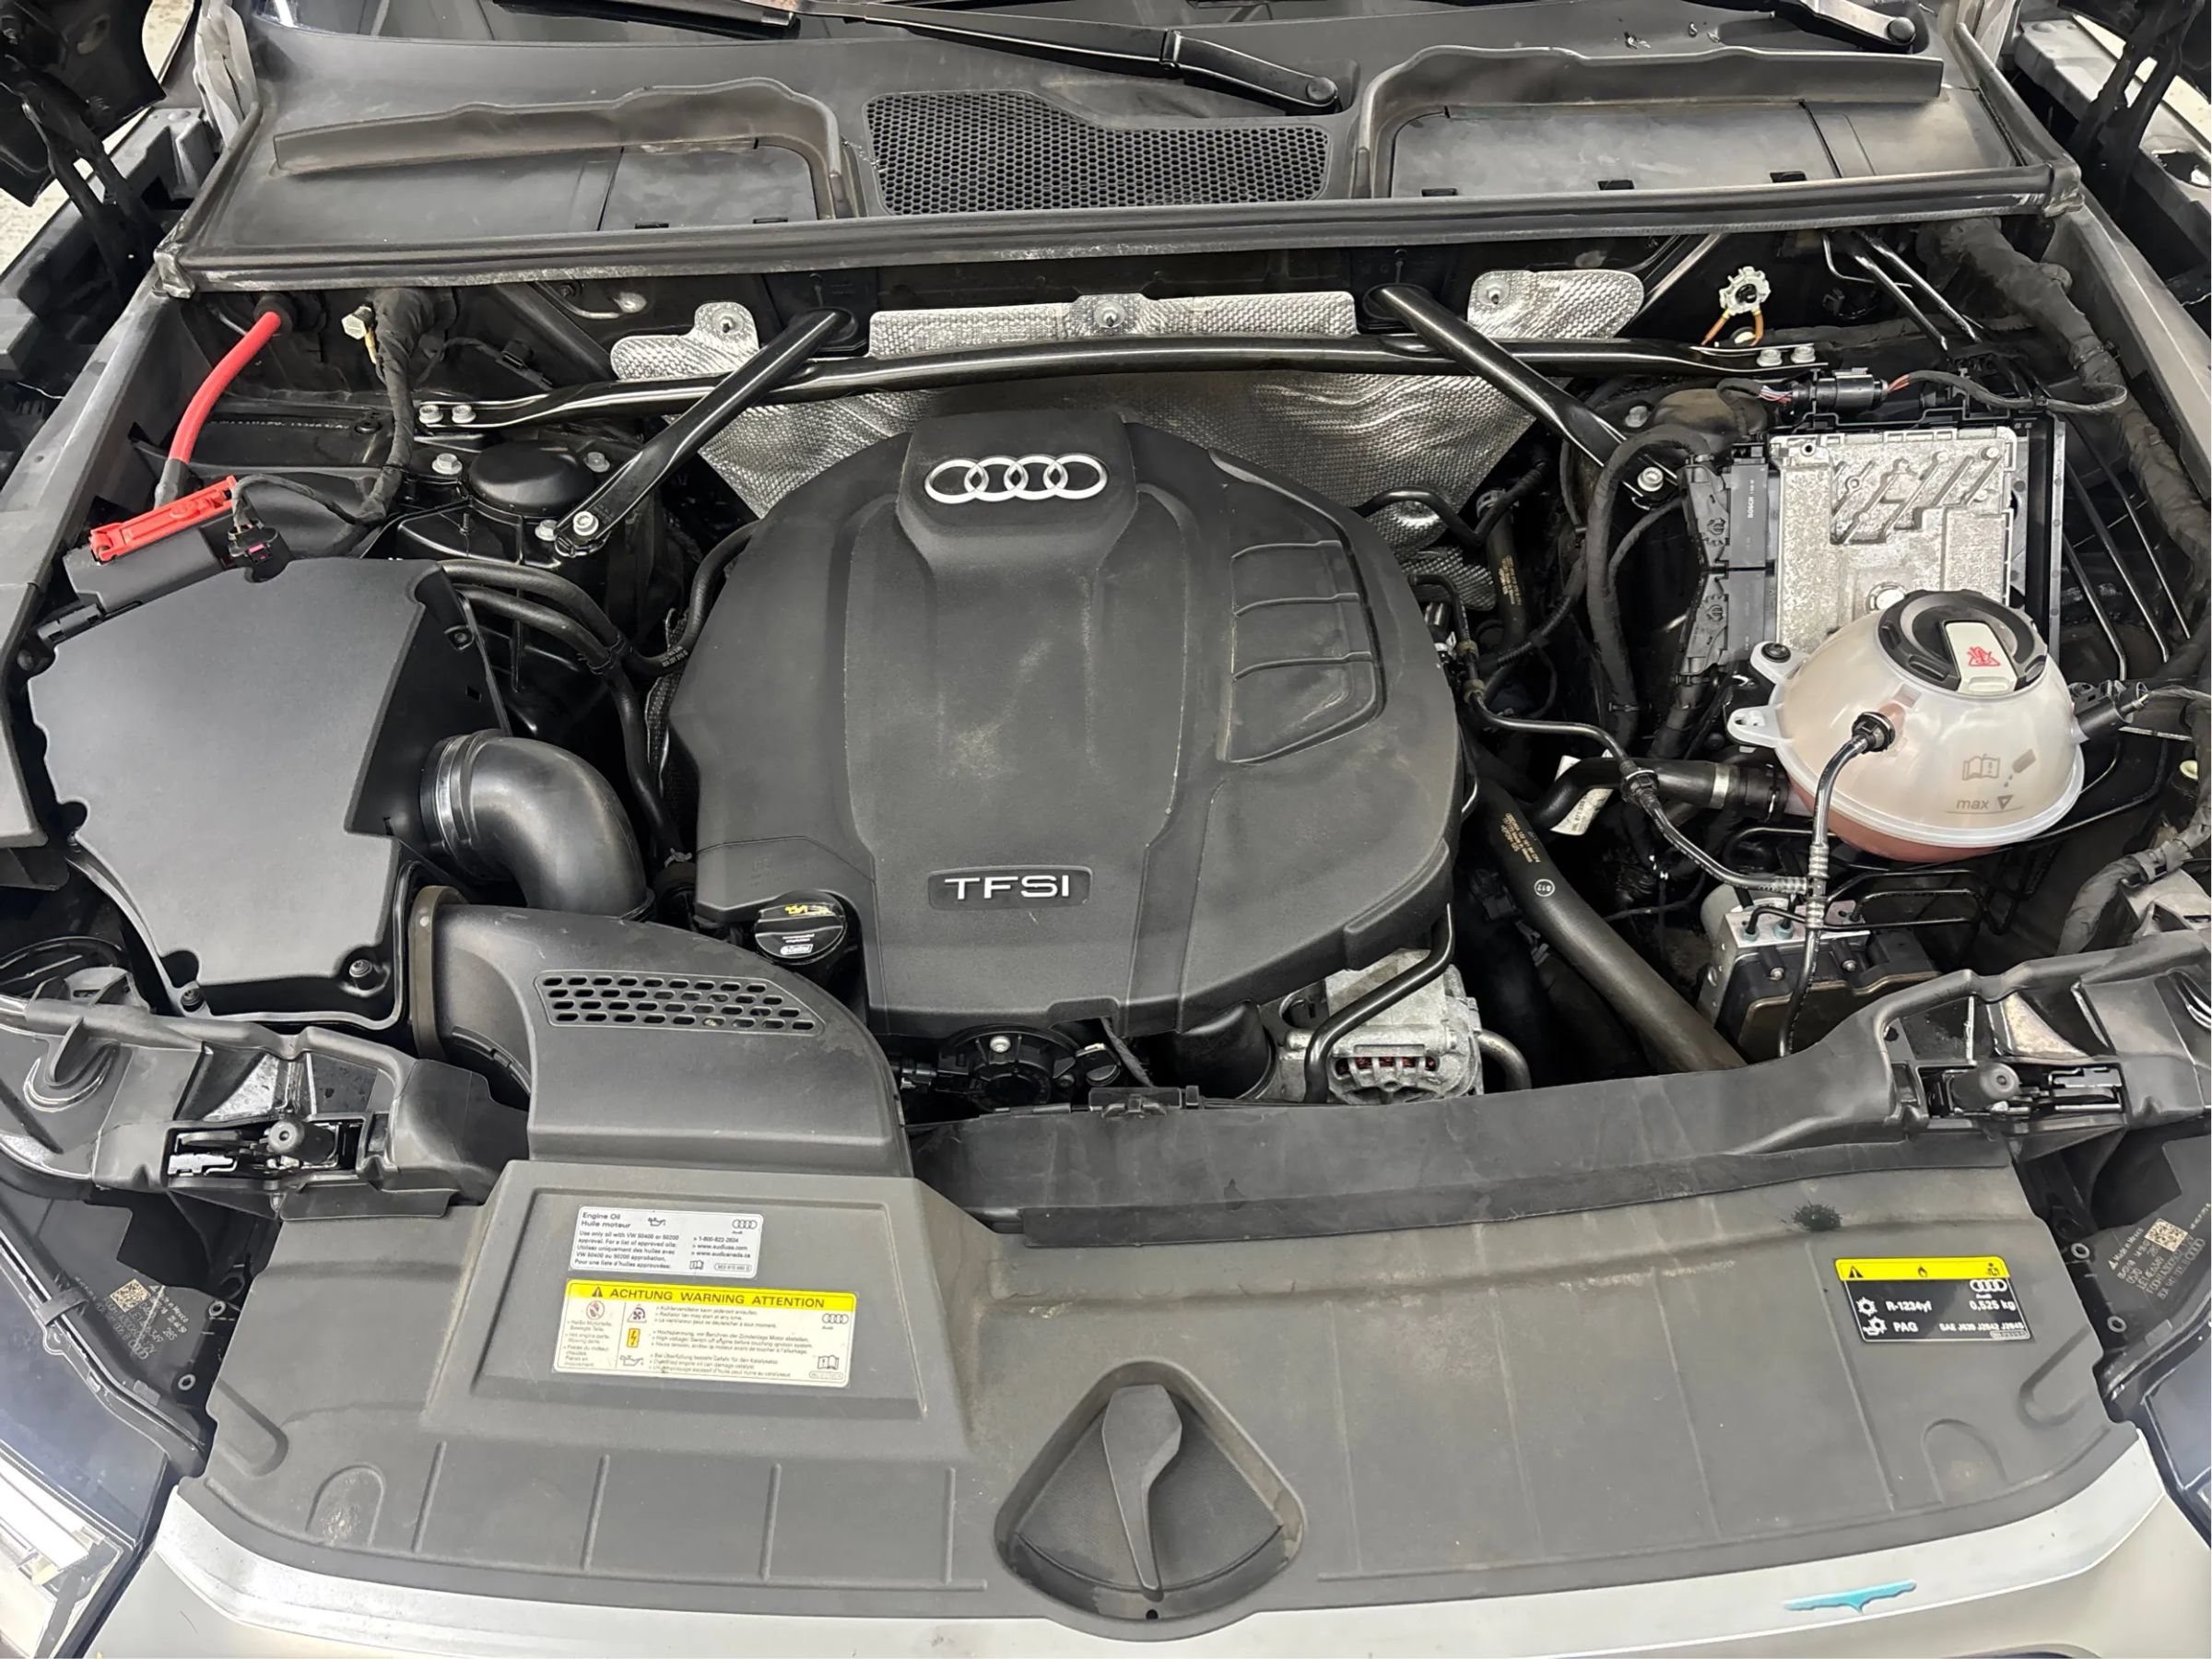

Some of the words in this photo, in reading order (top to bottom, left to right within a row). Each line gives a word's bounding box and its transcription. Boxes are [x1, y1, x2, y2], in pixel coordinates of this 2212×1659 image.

[1956, 799, 1989, 809] max
[945, 875, 1069, 900] TFSI
[610, 1288, 673, 1300] ACHTUNG
[680, 1292, 745, 1304] WARNING
[752, 1296, 825, 1308] ATTENTION
[1885, 1300, 1933, 1312] R-1234yf
[1969, 1300, 1999, 1312] 0,525
[2000, 1300, 2017, 1312] kg
[1892, 1322, 1919, 1333] PAG
